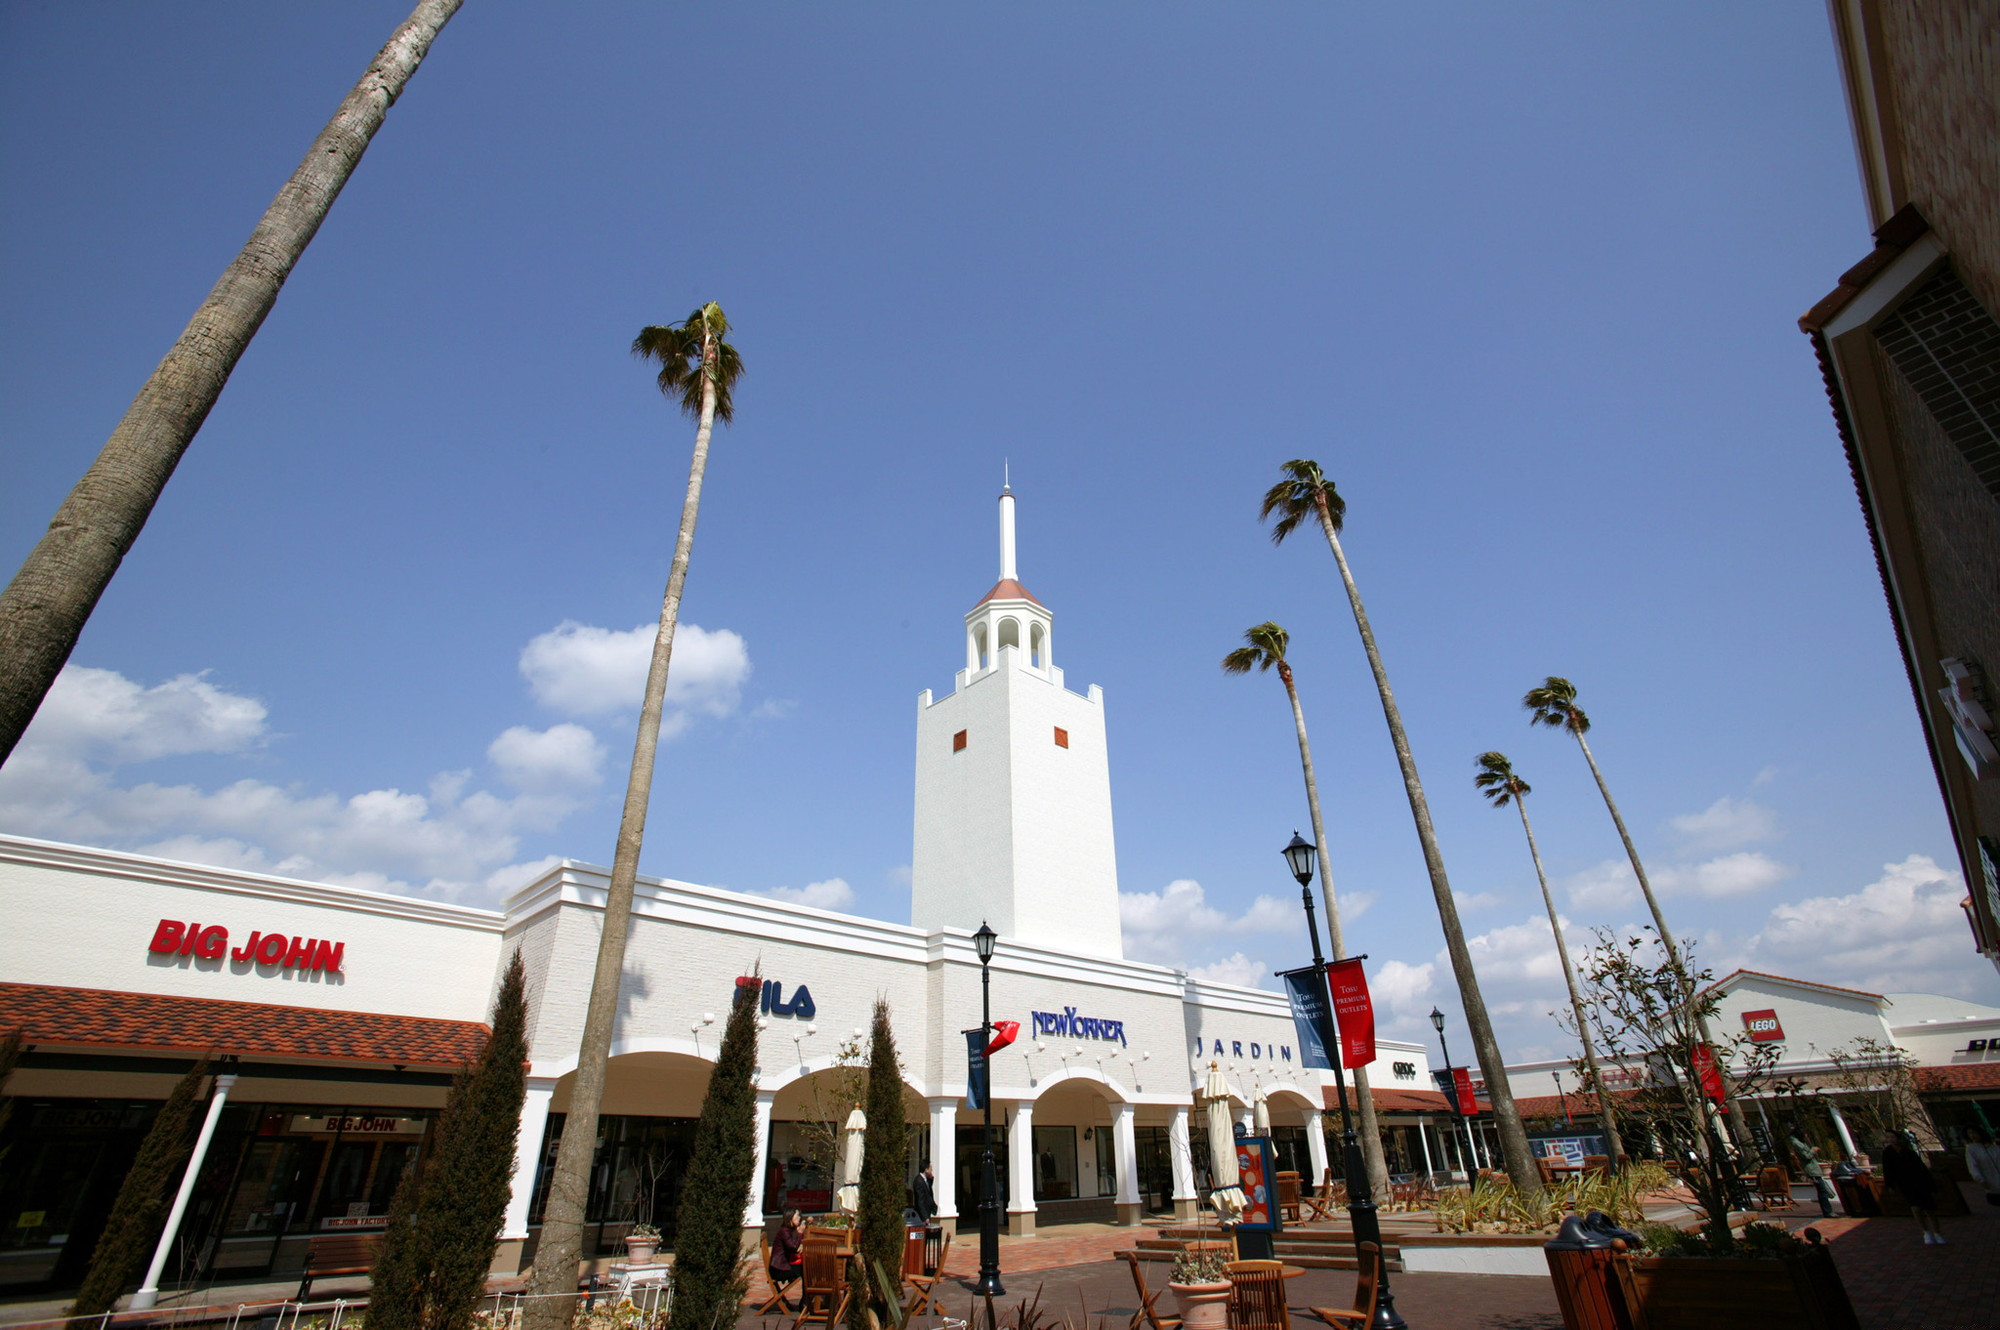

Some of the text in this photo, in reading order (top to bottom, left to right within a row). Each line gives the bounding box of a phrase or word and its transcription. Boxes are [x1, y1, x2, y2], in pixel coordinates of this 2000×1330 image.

[149, 919, 345, 972] BIG JOHN
[1336, 994, 1367, 1005] PREMIUM
[1339, 1004, 1368, 1014] OUTLETS
[1750, 1019, 1777, 1032] LEGO
[1196, 1036, 1292, 1062] JARDIN
[354, 1118, 396, 1132] JOHN
